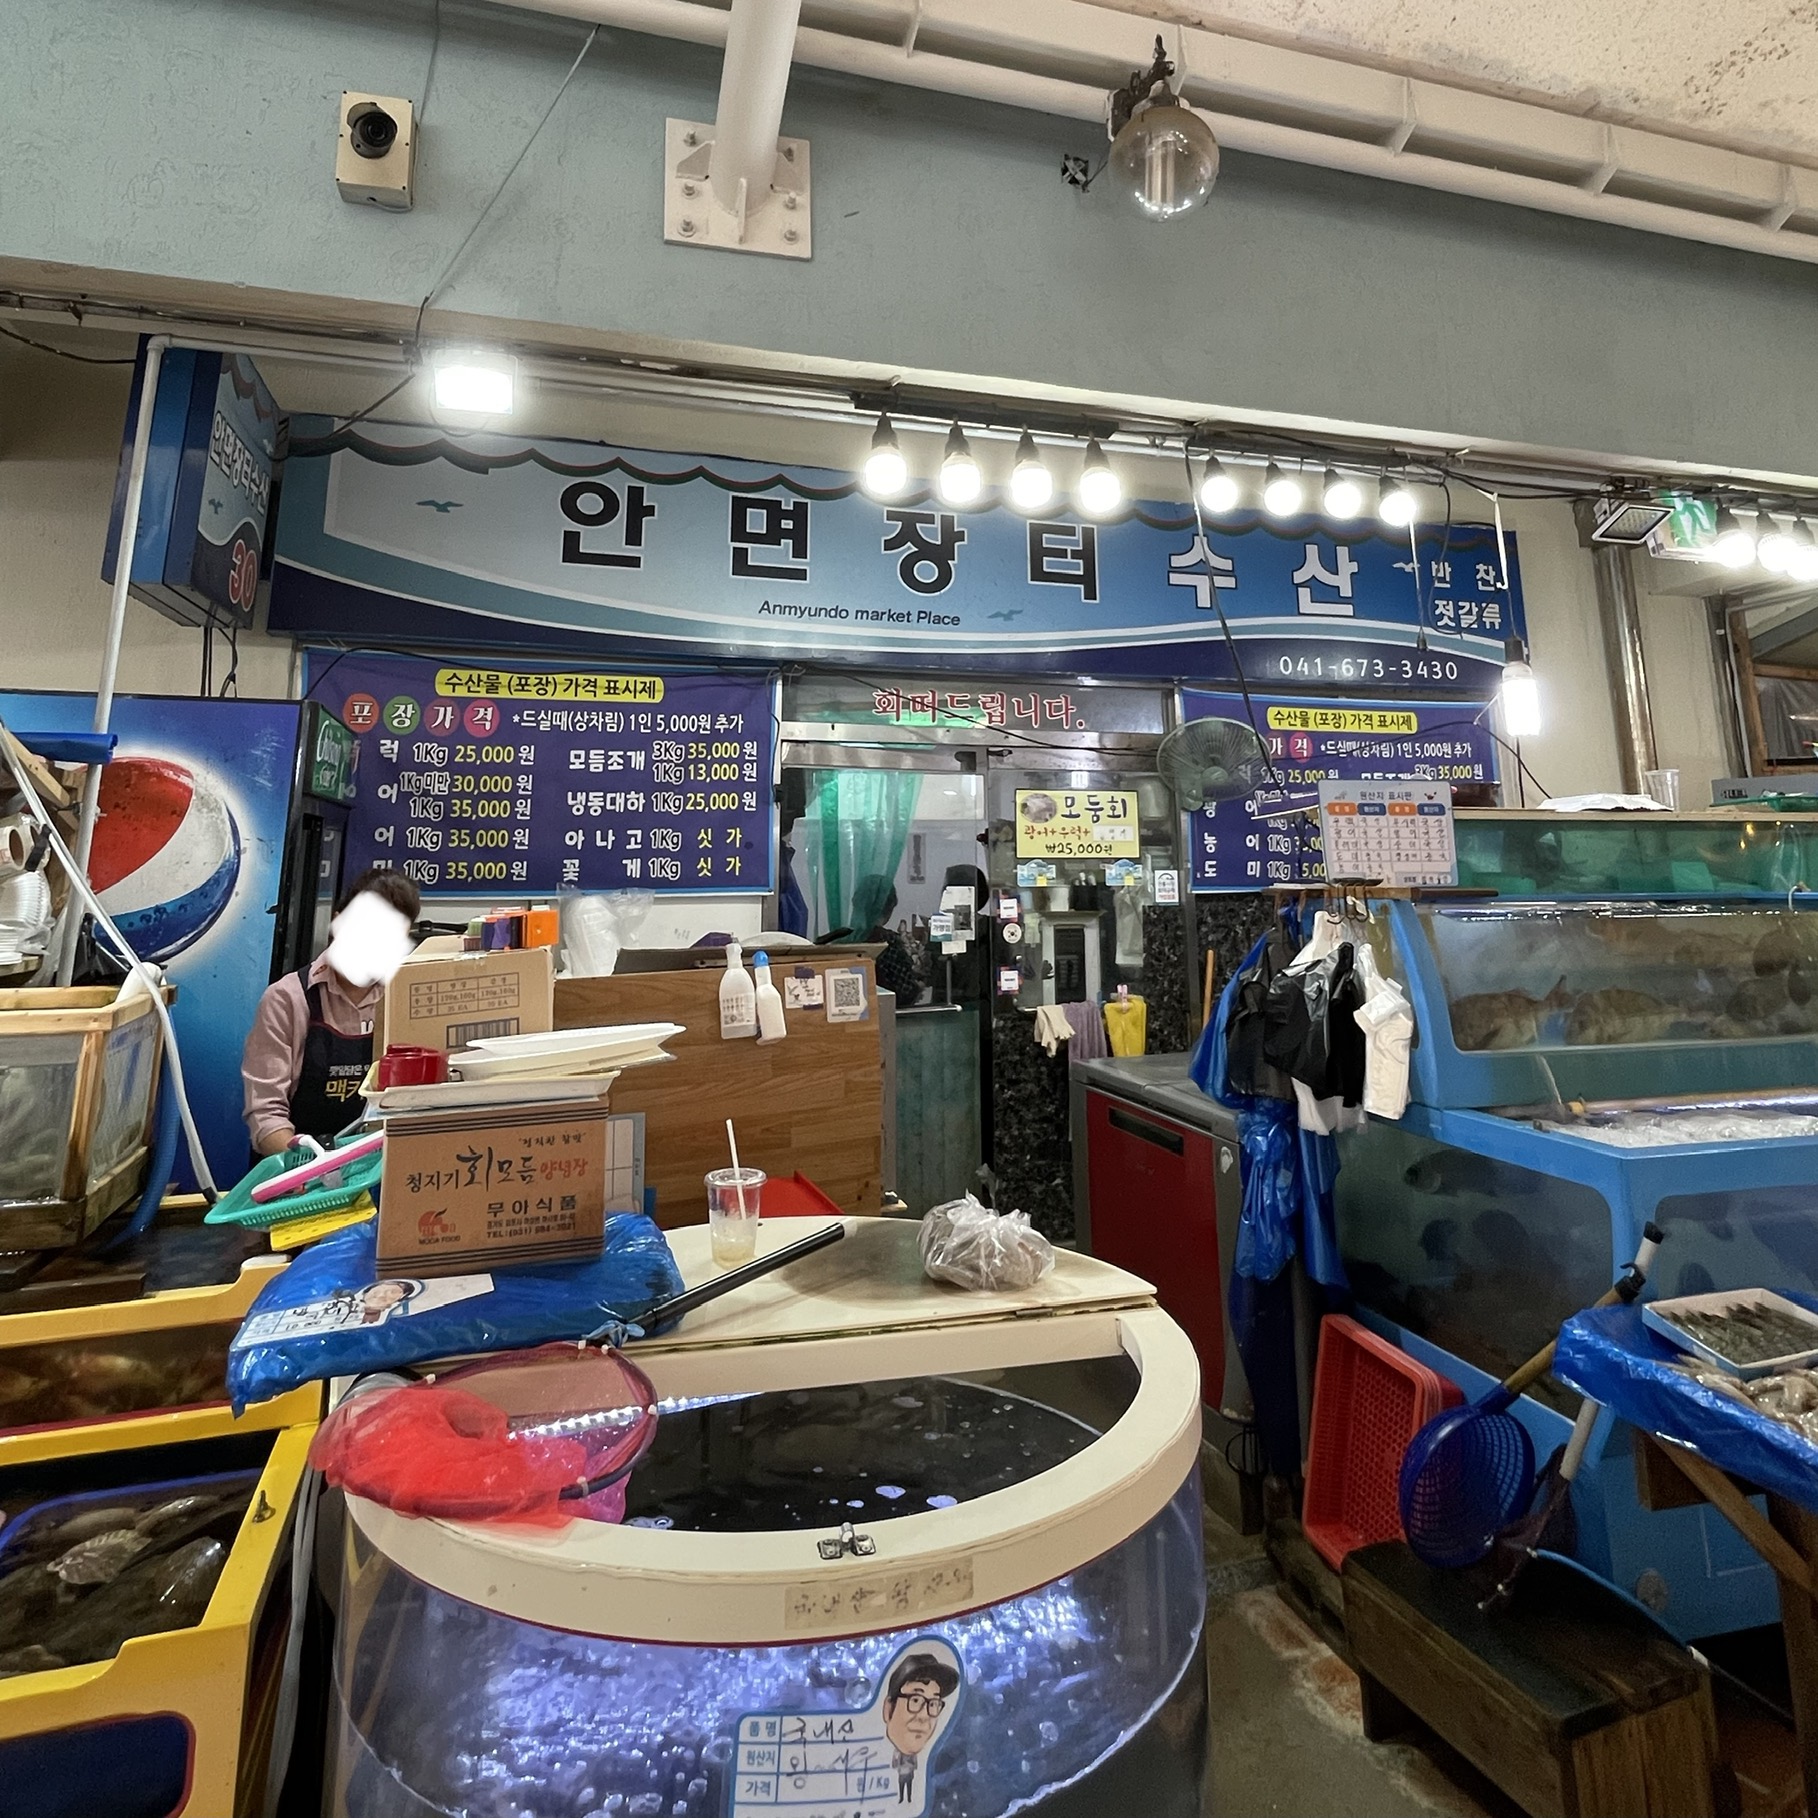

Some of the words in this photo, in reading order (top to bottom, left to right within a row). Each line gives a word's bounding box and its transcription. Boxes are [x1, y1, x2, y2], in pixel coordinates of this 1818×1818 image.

[210, 410, 270, 517] 안면장터수산
[229, 538, 258, 613] 30
[758, 600, 849, 619] Anmyundo
[854, 608, 912, 624] market
[917, 610, 960, 626] Place
[1433, 599, 1502, 630] 젓갈류
[1279, 655, 1459, 681] 041-673-3430
[444, 672, 502, 694] 수산물
[507, 674, 557, 697] (포장)
[562, 677, 597, 698] 가격
[603, 678, 656, 699] 표시제
[629, 713, 652, 733] 1인
[656, 714, 711, 735] 5,000원
[714, 714, 744, 734] 추가
[1273, 710, 1310, 728] 수산물
[1314, 712, 1346, 729] (포장)
[1350, 713, 1374, 730] 가격
[1377, 714, 1413, 731] 표시제
[412, 741, 449, 767] 1Kg
[454, 745, 514, 765] 25,000
[517, 744, 535, 765] 원
[568, 749, 646, 773] 모듬조개
[652, 741, 685, 764] 3Kg
[687, 742, 740, 761] 35,000
[742, 741, 758, 760] 원
[1397, 742, 1413, 758] 1인
[1415, 742, 1452, 759] 5,000원
[1454, 742, 1472, 758] 추가
[652, 763, 685, 785] 1Kg
[688, 763, 739, 783] 13,000
[742, 762, 757, 783] 원
[1438, 765, 1472, 781] 35,000
[1473, 763, 1484, 779] 원
[452, 775, 513, 796] 30,000
[516, 773, 533, 795] 원
[1359, 791, 1384, 801] 원산지
[409, 797, 444, 821] 1Kg
[450, 799, 511, 820] 35,000
[514, 798, 531, 820] 원
[566, 790, 646, 816] 냉동대하
[651, 792, 684, 815] 1Kg
[685, 792, 739, 813] 25,000
[741, 791, 757, 812] 원
[406, 826, 442, 851] 1Kg
[448, 829, 509, 850] 35,000
[512, 828, 530, 850] 원
[650, 828, 682, 851] 1Kg
[1267, 834, 1291, 854] 1Kg
[403, 860, 440, 884] 1Kg
[445, 862, 507, 883] 35,000
[510, 861, 527, 881] 원
[648, 857, 681, 880] 1Kg
[1267, 861, 1291, 880] 1Kg
[406, 1170, 460, 1193] 청지기
[456, 1145, 494, 1192] 회
[540, 1158, 589, 1180] 양념장
[745, 1780, 771, 1797] 가격
